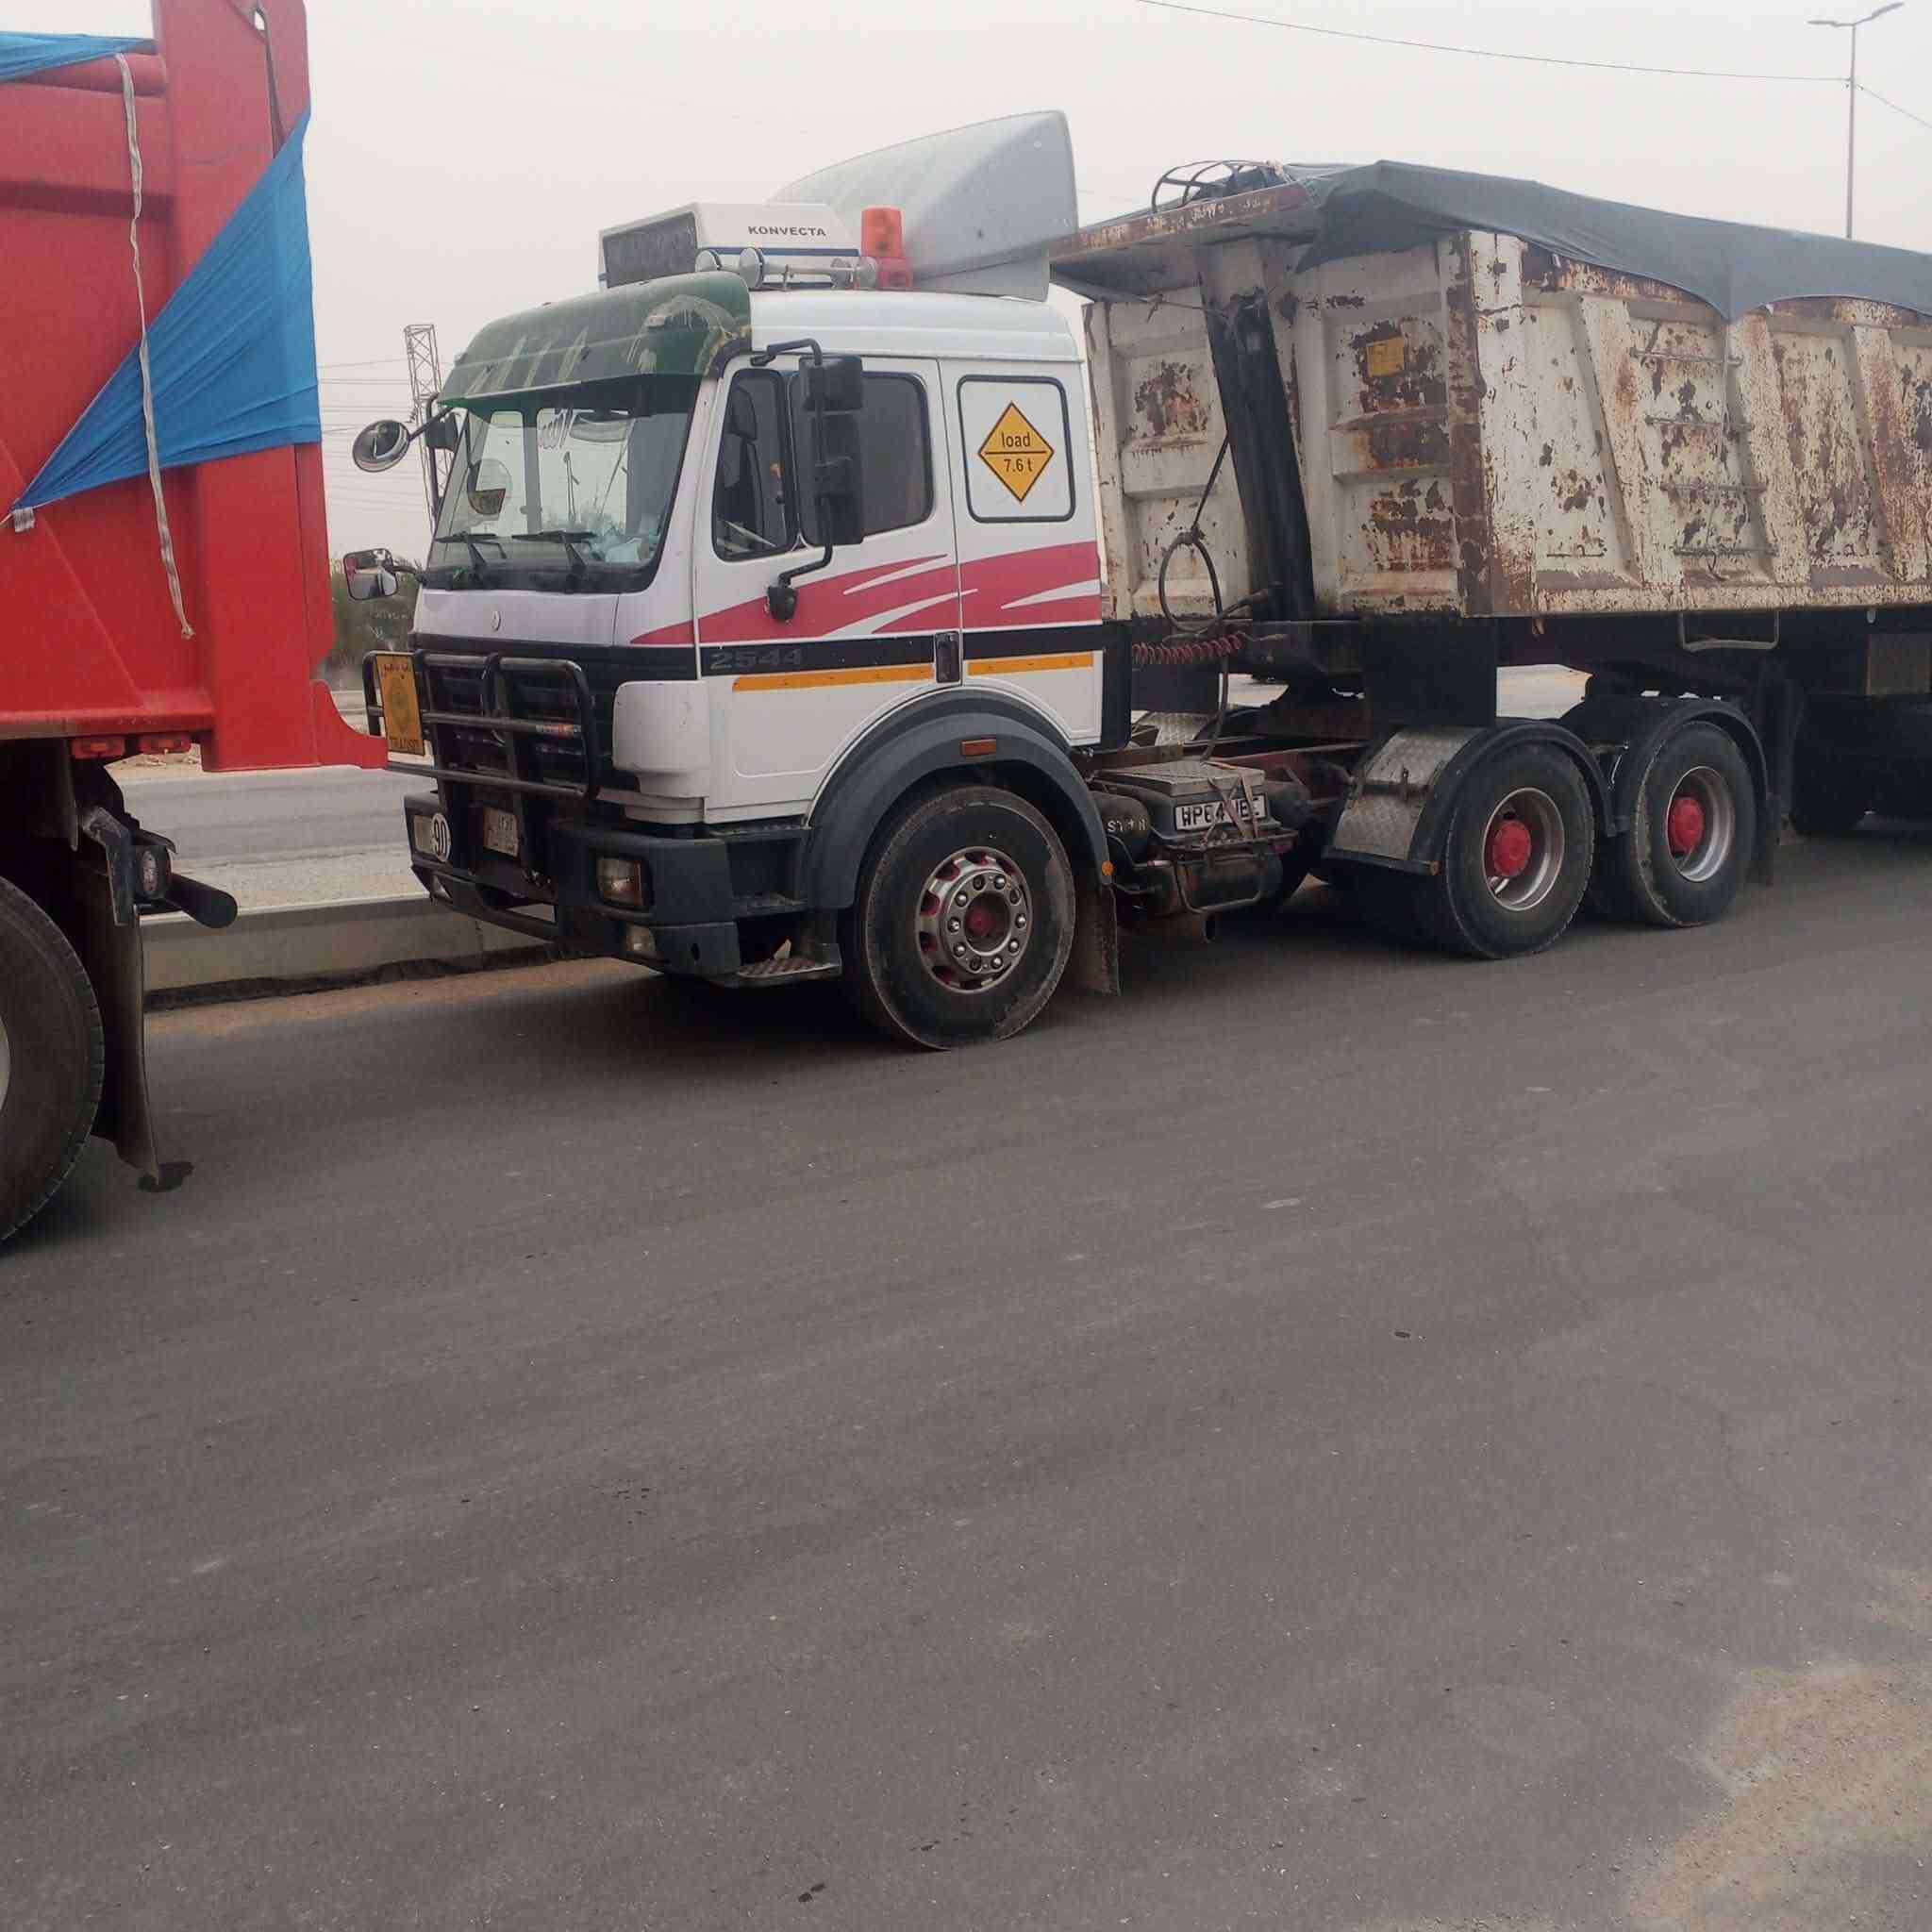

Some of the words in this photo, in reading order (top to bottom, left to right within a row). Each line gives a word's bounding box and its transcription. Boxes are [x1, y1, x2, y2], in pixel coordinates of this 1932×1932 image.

[747, 225, 826, 236] KONVECTA
[1001, 431, 1031, 447] load
[1004, 458, 1024, 473] 7.6
[1026, 458, 1033, 472] t
[709, 648, 802, 671] 2544
[433, 820, 448, 857] 90
